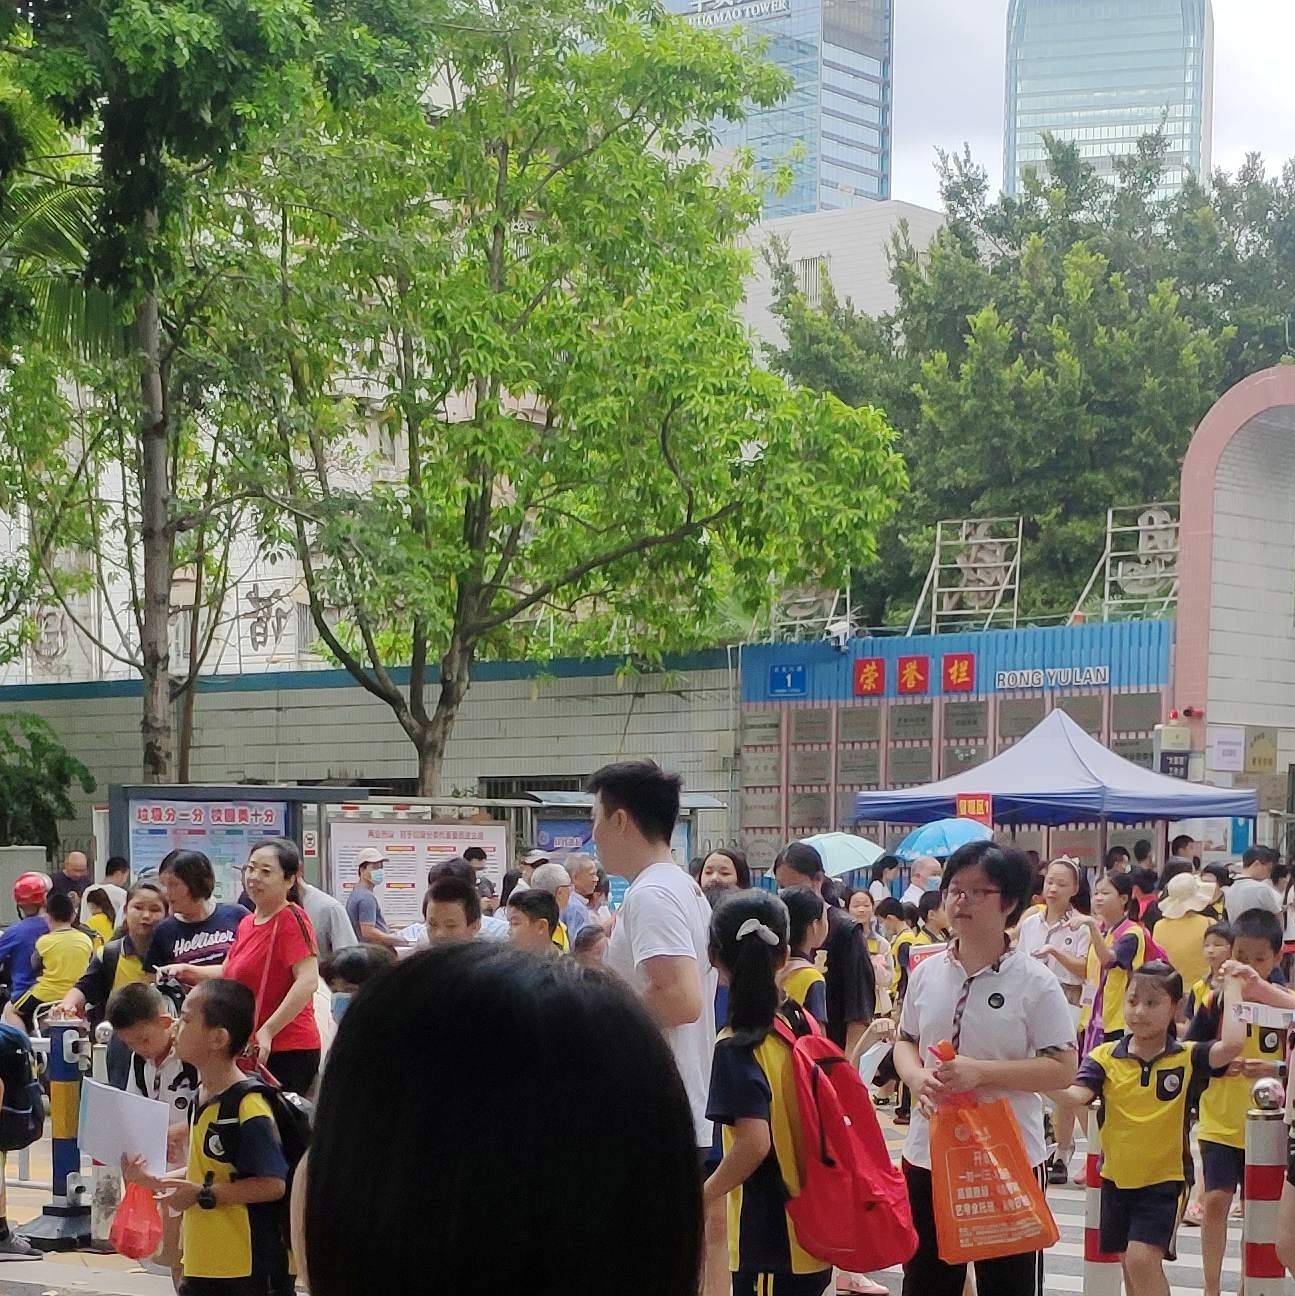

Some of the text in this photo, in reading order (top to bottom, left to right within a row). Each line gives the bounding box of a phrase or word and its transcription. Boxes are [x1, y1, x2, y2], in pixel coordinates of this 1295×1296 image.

[742, 0, 787, 17] TOWER
[785, 673, 792, 688] 1
[859, 659, 971, 690] 荣誉栏
[996, 670, 1043, 689] RONG
[173, 930, 236, 957] Hollister
